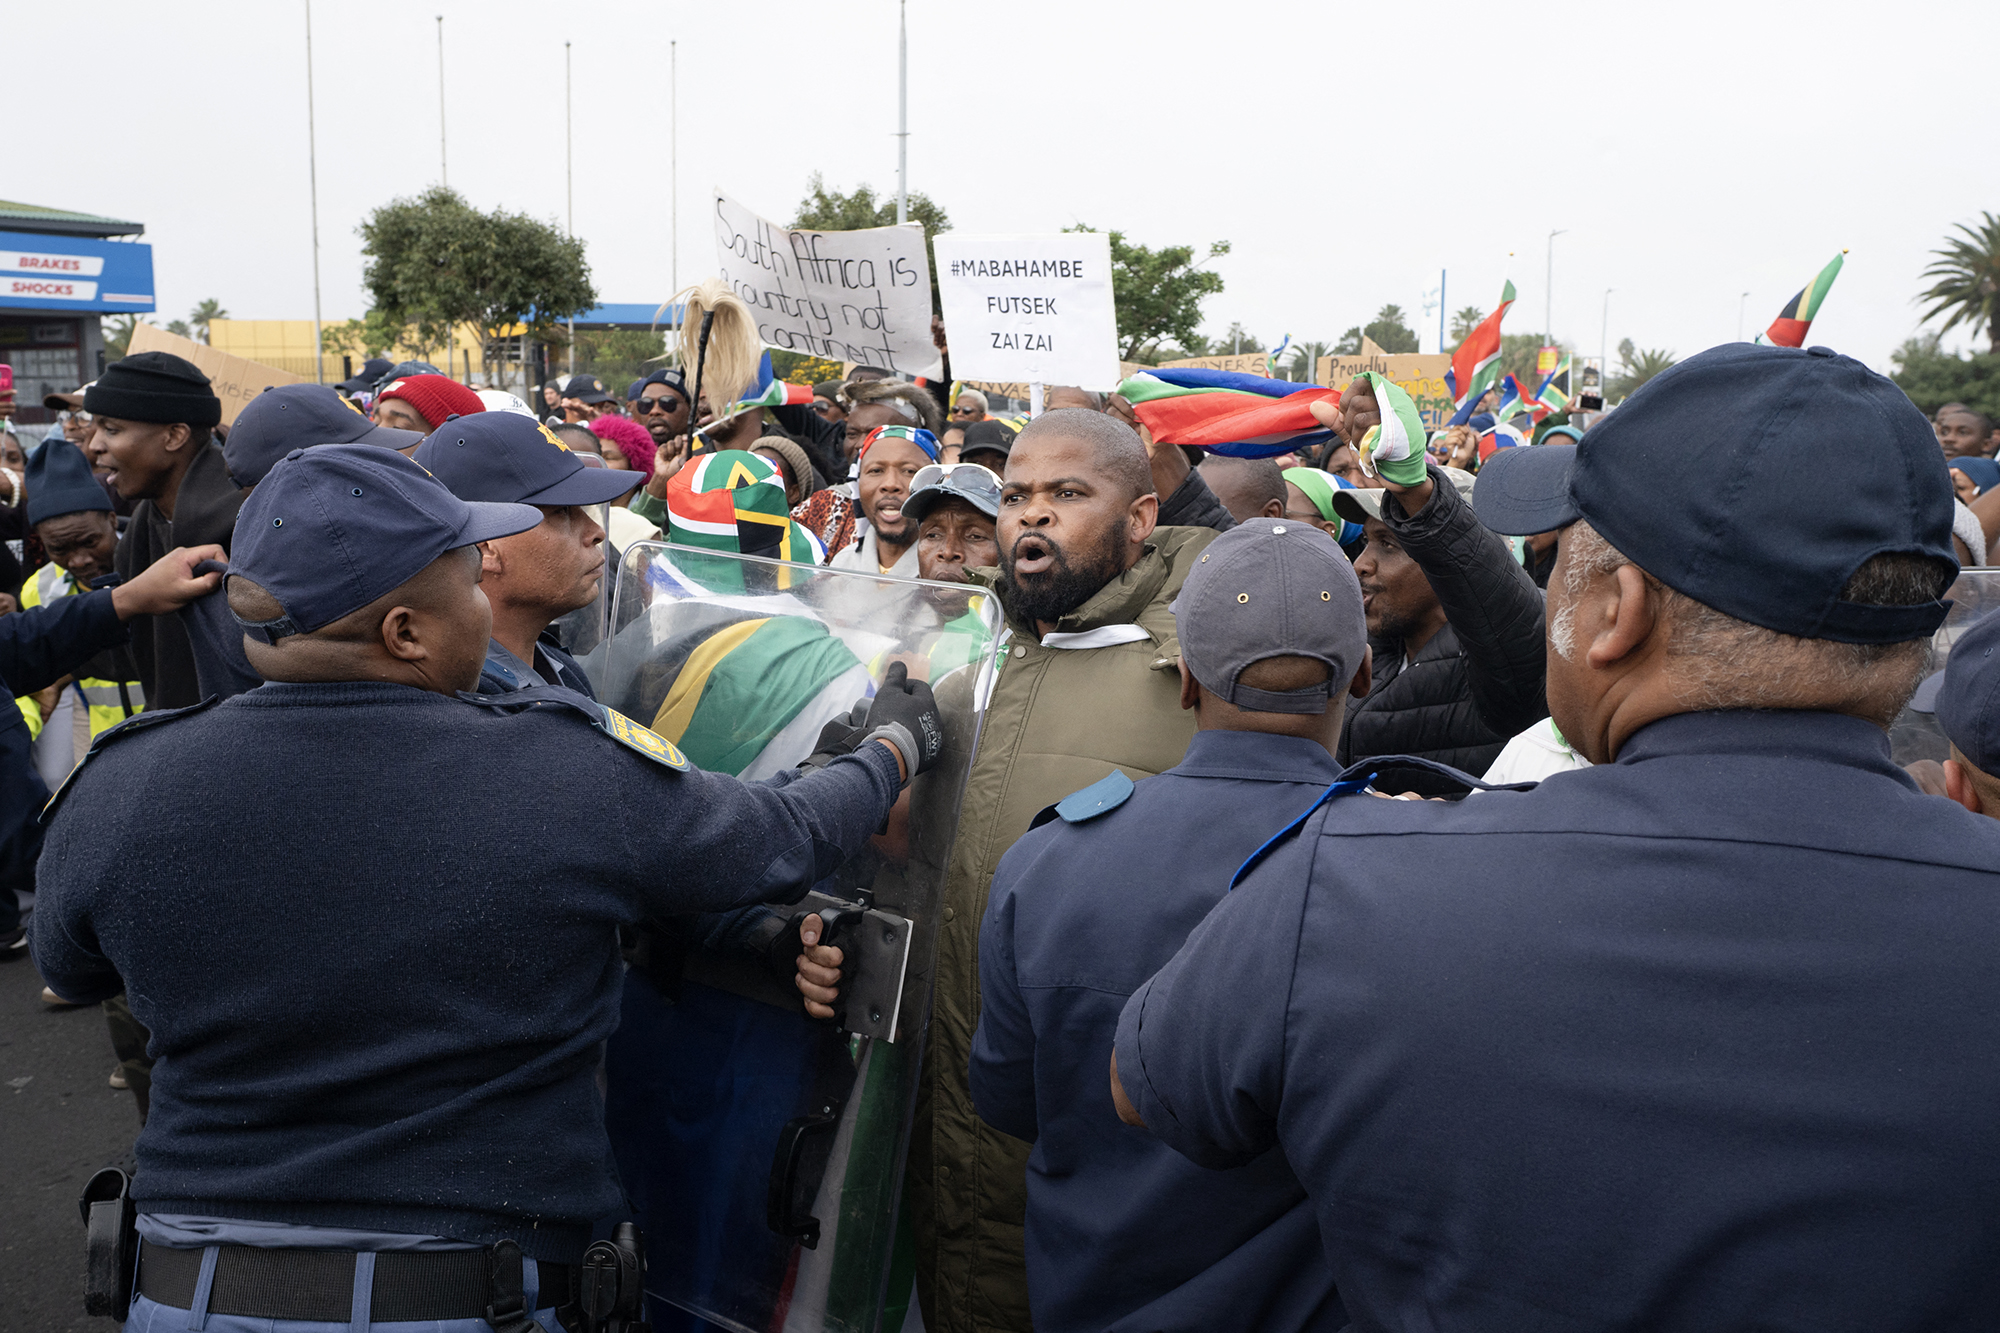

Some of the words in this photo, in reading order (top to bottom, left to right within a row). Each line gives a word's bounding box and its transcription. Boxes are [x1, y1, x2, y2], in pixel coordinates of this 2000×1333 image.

[718, 198, 788, 277] South
[789, 232, 875, 289] Africa
[887, 248, 917, 286] is
[19, 257, 80, 271] BRAKES
[951, 260, 1083, 278] #MABAHAMBE
[12, 282, 73, 295] SHOCKS
[734, 276, 832, 335] country
[842, 290, 895, 334] not
[987, 297, 1057, 315] FUTSEK
[759, 321, 901, 372] continent
[991, 333, 1019, 349] ZAI
[1024, 334, 1052, 351] ZAI
[211, 376, 255, 401] MBE
